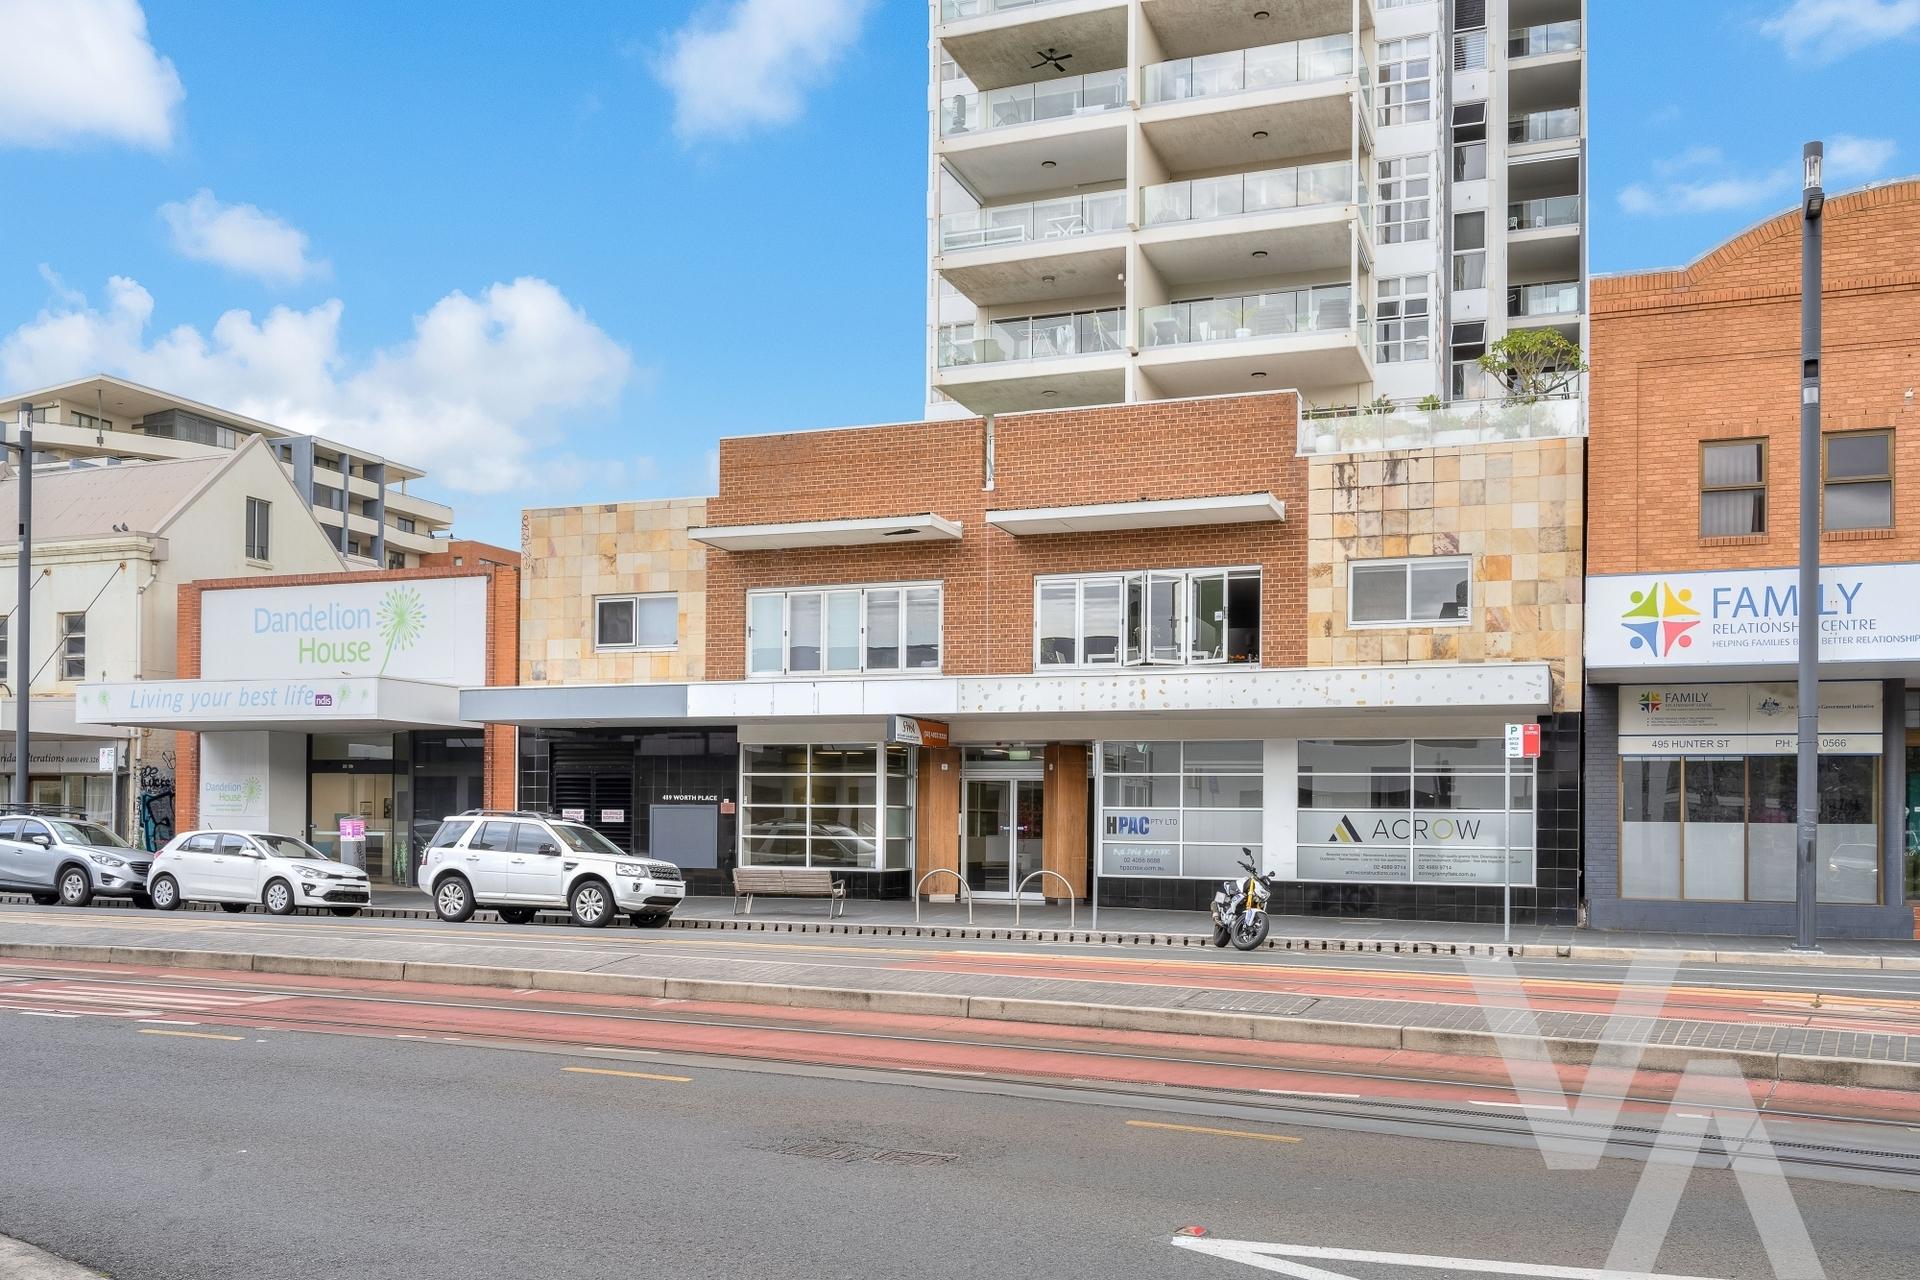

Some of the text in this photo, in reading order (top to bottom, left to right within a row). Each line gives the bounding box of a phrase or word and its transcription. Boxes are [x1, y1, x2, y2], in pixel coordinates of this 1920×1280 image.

[1713, 582, 1864, 619] FAMLY
[254, 604, 371, 635] Dandelion
[1713, 618, 1877, 635] RELATIONSH CENTRE
[1712, 638, 1749, 648] HELPING
[1752, 637, 1792, 648] FAMILIES
[1821, 636, 1853, 646] BETTER
[298, 637, 371, 664] House
[130, 684, 314, 713] Living your best life
[316, 695, 331, 706] ndis
[1665, 692, 1709, 703] FAMILY
[1510, 726, 1518, 735] P
[1652, 739, 1730, 748] 495 HUNTER ST
[1775, 739, 1793, 748] PH:
[1822, 738, 1847, 748] 0566
[0, 752, 17, 763] rida
[27, 752, 65, 763] lterations
[205, 782, 242, 792] Dandelion
[219, 792, 242, 802] House
[1106, 816, 1150, 835] HPAC
[1165, 818, 1178, 826] LTD
[1372, 818, 1481, 841] ACROW
